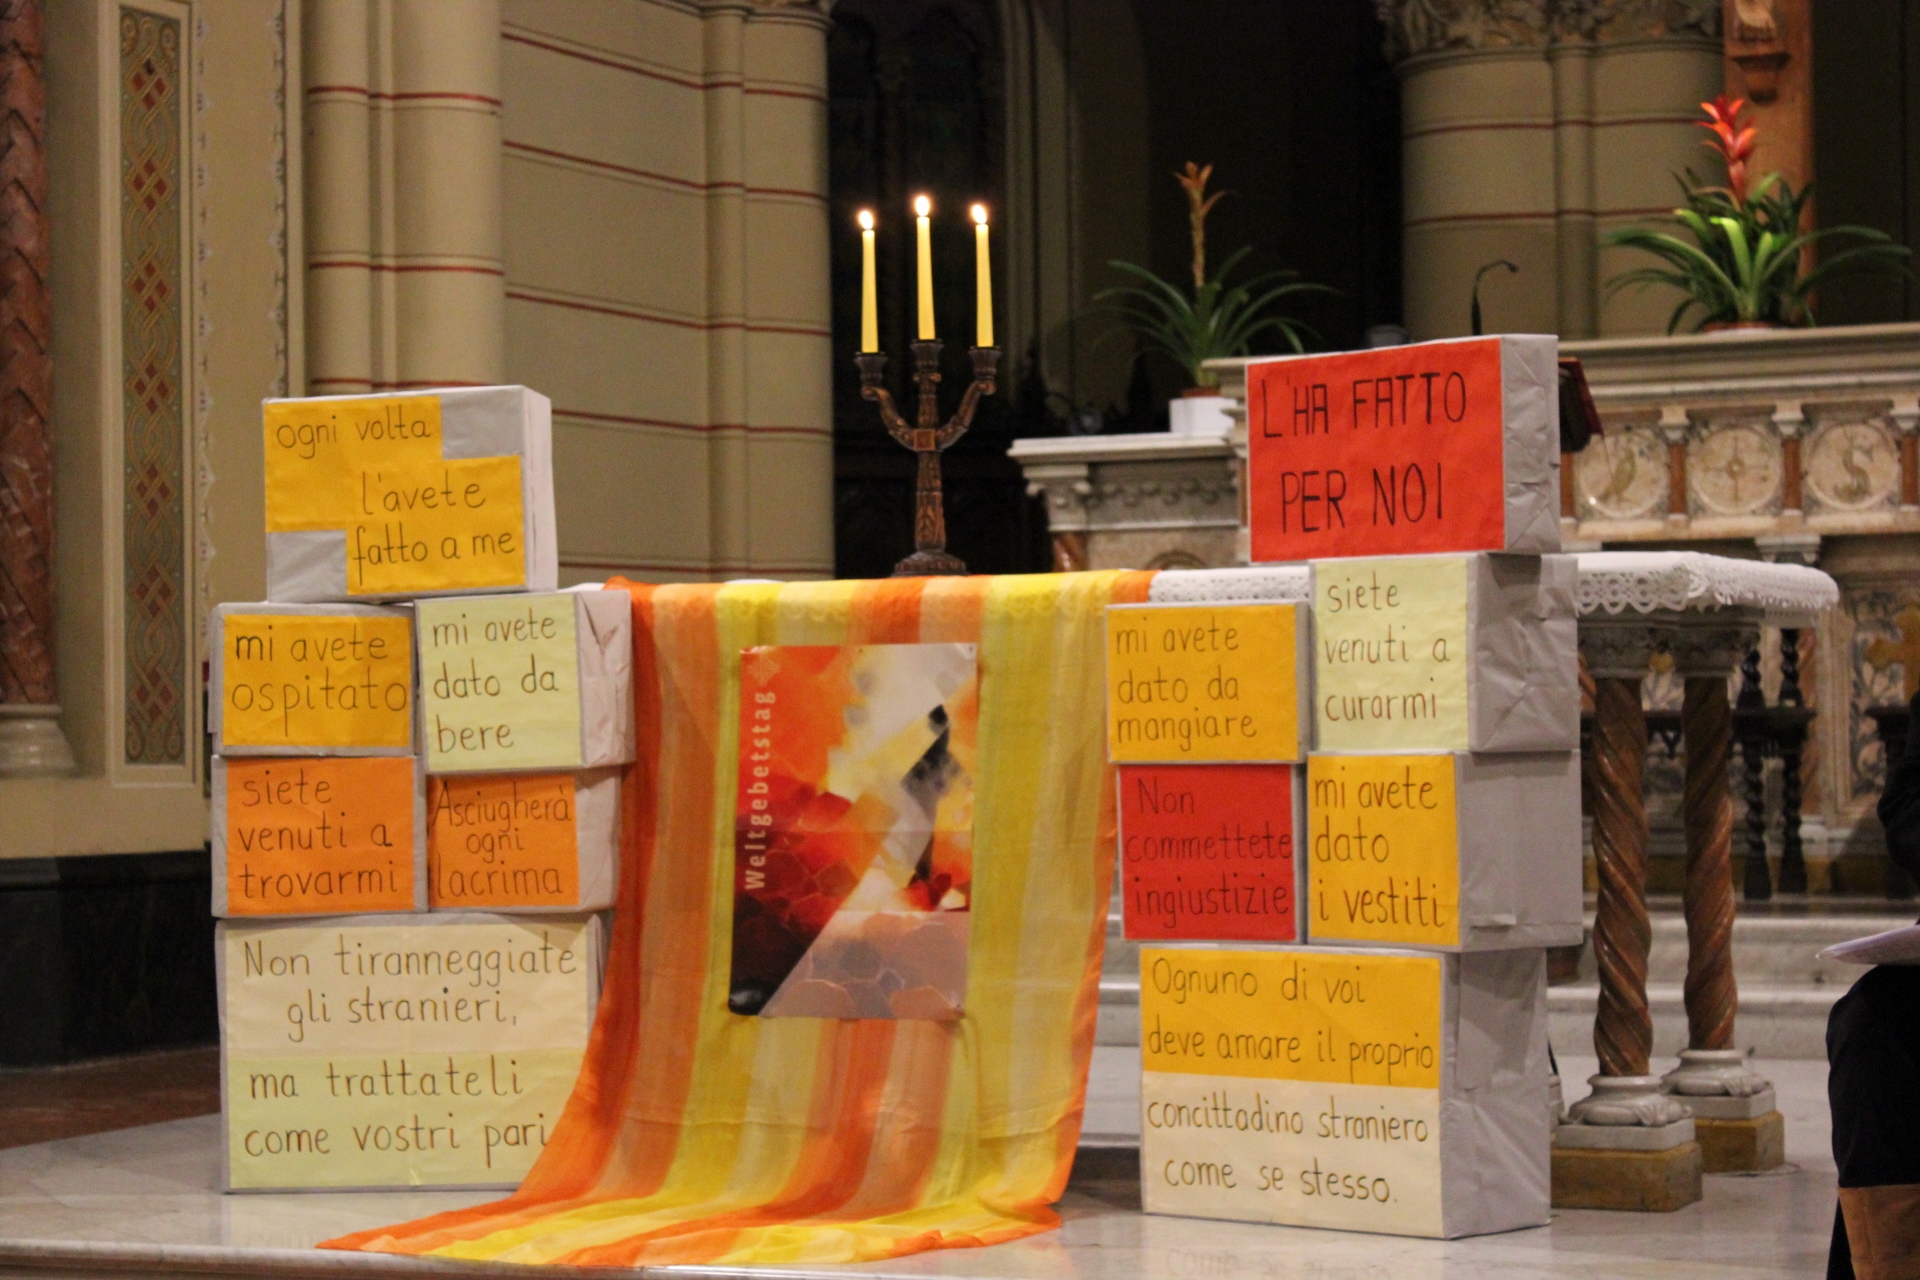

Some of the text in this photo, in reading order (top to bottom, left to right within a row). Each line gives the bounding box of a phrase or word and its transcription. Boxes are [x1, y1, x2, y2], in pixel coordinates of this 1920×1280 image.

[1262, 371, 1466, 438] L'HA FATTO
[276, 404, 431, 460] ogni volta
[362, 470, 486, 515] l'avete
[1281, 462, 1442, 533] PER NOI
[353, 522, 515, 586] fatto a me
[1327, 571, 1401, 613] siete
[235, 624, 389, 663] mi avete
[433, 607, 556, 648] mi avete
[1116, 617, 1240, 654] mi avete
[1325, 624, 1450, 664] venuti a
[433, 653, 559, 700] dato da
[1117, 665, 1239, 704] dato da
[1325, 677, 1437, 721] curarmi
[231, 667, 408, 737] ospitato
[437, 714, 514, 753] bere
[1117, 707, 1257, 752] mangiare
[243, 768, 333, 807] siete
[432, 781, 572, 832] Asciugherà
[744, 691, 776, 891] Weltgebetstag
[1137, 776, 1195, 815] Non
[1314, 766, 1438, 809] mi avete
[237, 811, 393, 852] venuti a
[466, 827, 524, 863] ogni
[1125, 821, 1292, 862] commettete
[1315, 815, 1389, 863] dato
[239, 860, 398, 899] trovarmi
[437, 860, 563, 899] lacrima
[1135, 872, 1289, 928] ingiustizie
[1319, 877, 1446, 928] i vestiti
[244, 931, 577, 987] Non tiranneggiate
[1153, 958, 1365, 1004] Ognuno di voi
[287, 986, 517, 1042] gli stranieri,
[1149, 1013, 1433, 1084] deve amare il proprio
[250, 1055, 524, 1099] ma trattateli
[1148, 1090, 1428, 1143] concittadino straniero
[245, 1113, 546, 1168] come vostri pari
[1164, 1157, 1397, 1203] come se stesso.
